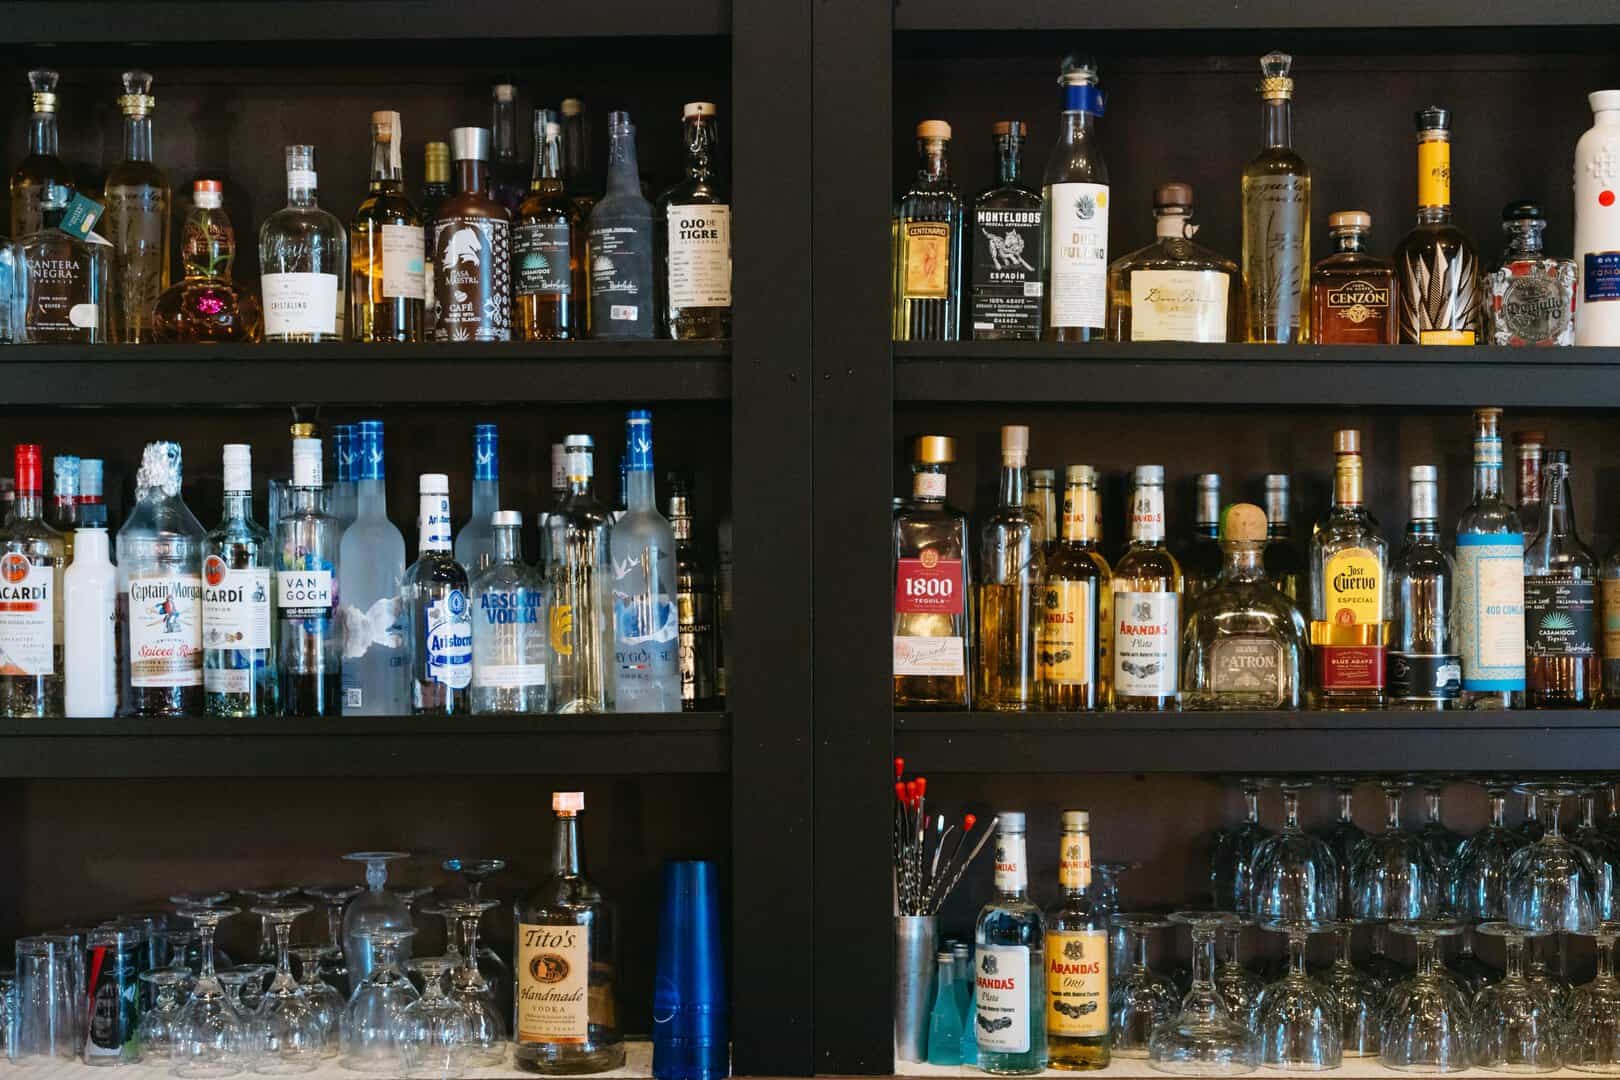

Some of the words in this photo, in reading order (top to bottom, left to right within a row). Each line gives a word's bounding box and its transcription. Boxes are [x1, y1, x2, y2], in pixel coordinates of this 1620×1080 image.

[978, 211, 1041, 223] MONTELOBOS
[680, 219, 705, 229] OJO
[680, 230, 719, 240] TIGRE
[26, 259, 80, 270] CANTERA
[33, 269, 73, 279] NEGRA
[990, 271, 1025, 280] ESPADÍN
[1330, 290, 1386, 304] CENZÓN
[286, 578, 317, 589] VAN
[905, 577, 954, 597] 1800
[1333, 573, 1376, 593] Cuervo
[131, 581, 169, 601] Captain
[172, 581, 204, 601] Morga
[286, 590, 328, 601] GOGH
[1119, 619, 1169, 636] ARANDAS
[1220, 653, 1276, 669] PATRÓN
[524, 928, 577, 948] Tito's
[1050, 959, 1100, 975] ARANDAS
[520, 985, 584, 1003] Handmade
[532, 1005, 566, 1013] VODKA
